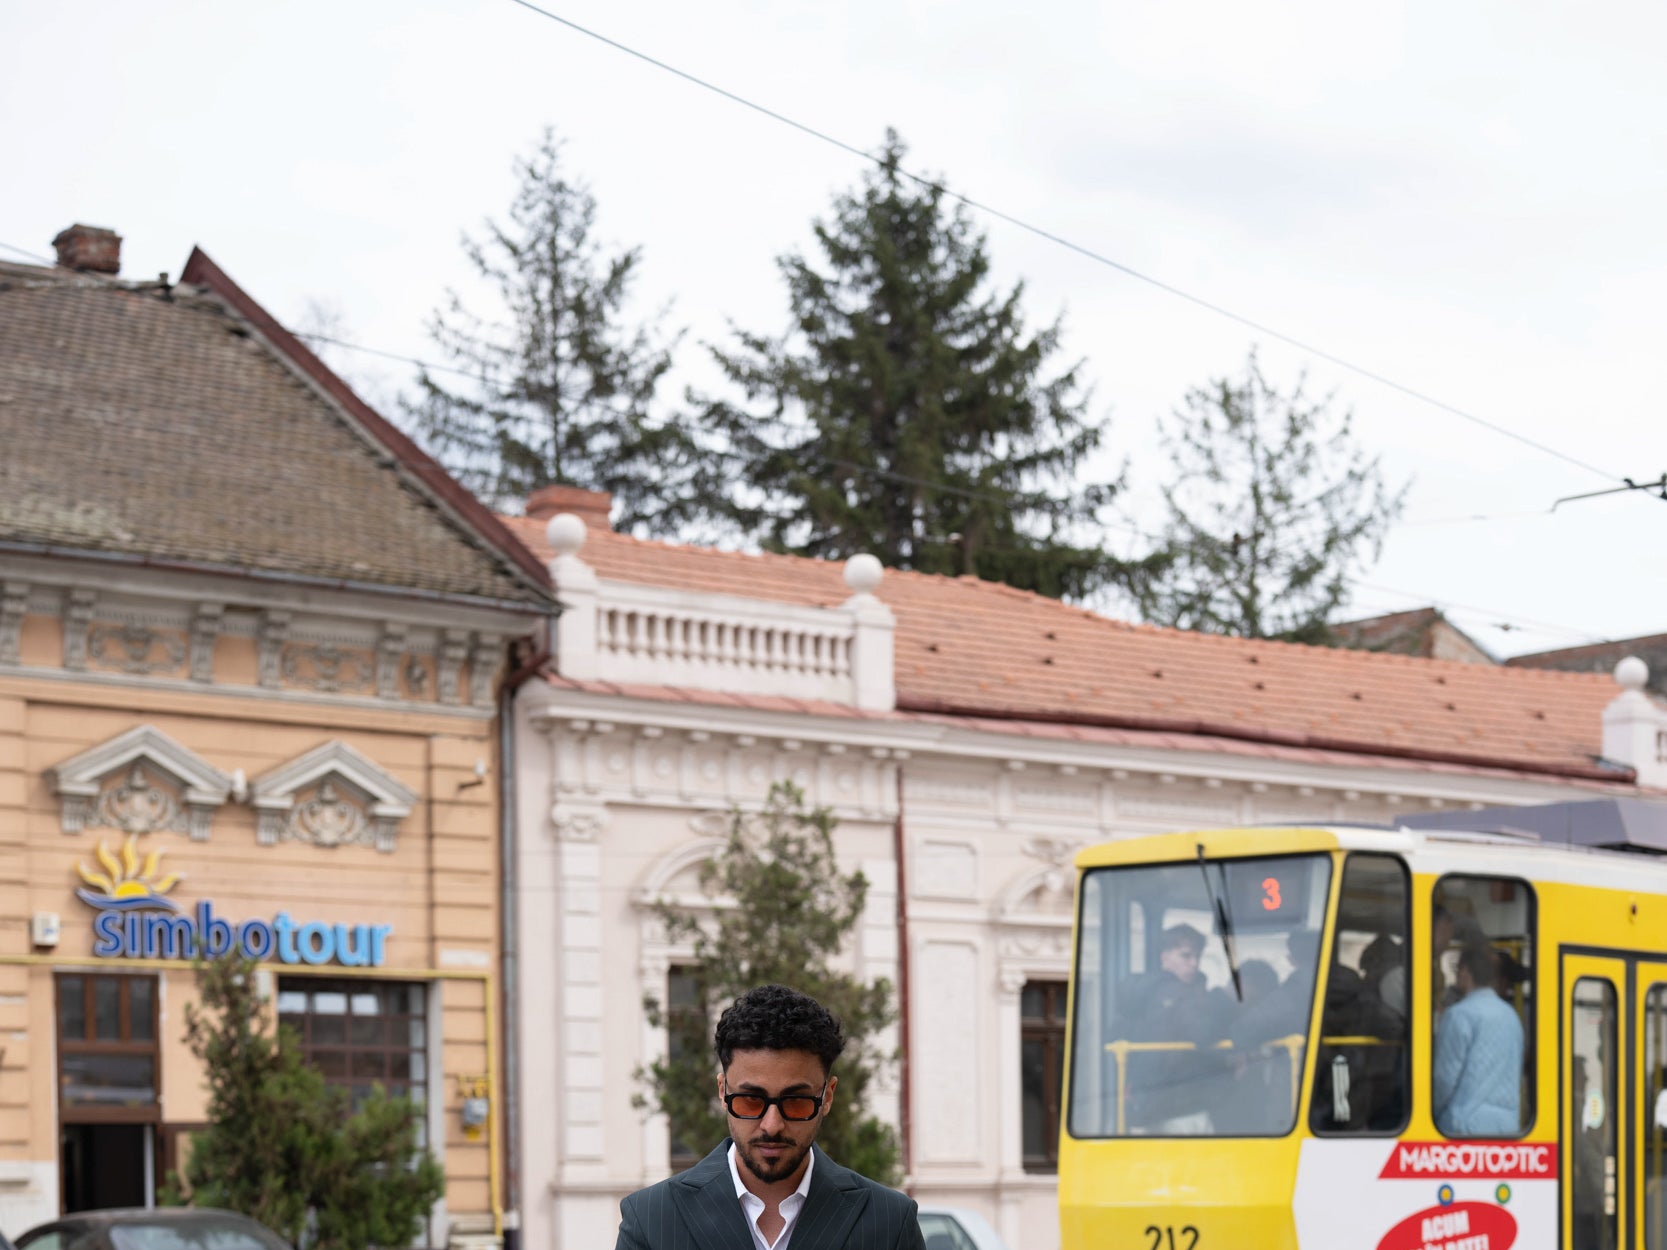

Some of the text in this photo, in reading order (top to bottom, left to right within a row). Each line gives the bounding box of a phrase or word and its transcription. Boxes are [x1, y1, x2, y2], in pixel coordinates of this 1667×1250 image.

[1262, 877, 1281, 911] 3
[94, 898, 392, 967] simbotour
[1421, 1209, 1471, 1243] ACUM
